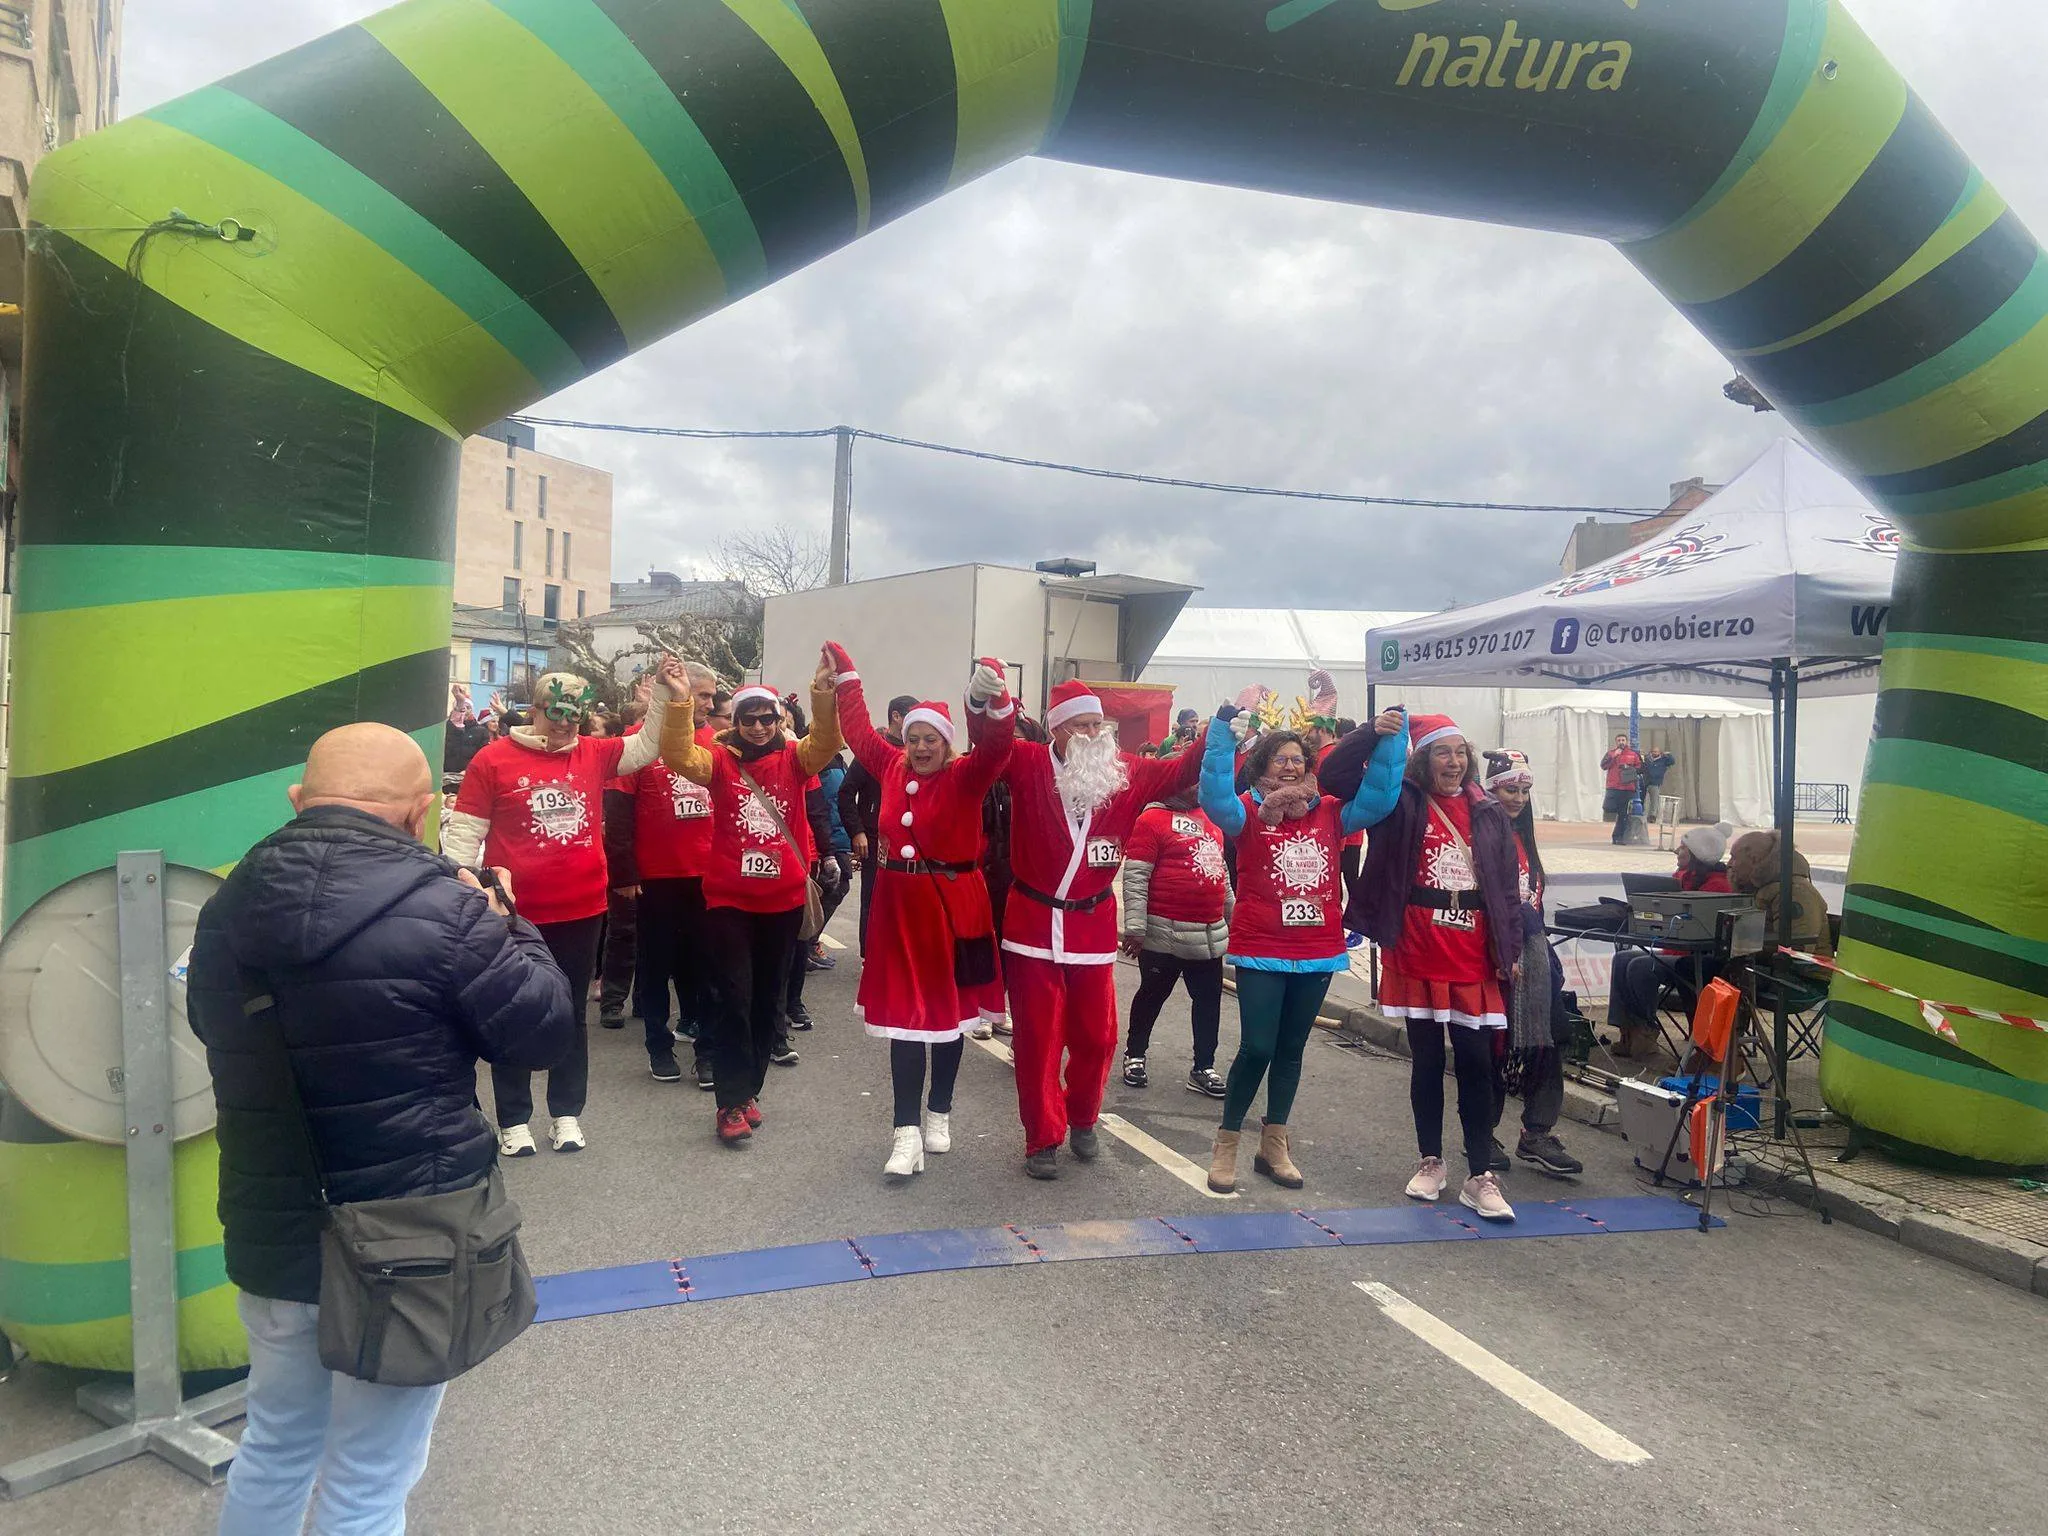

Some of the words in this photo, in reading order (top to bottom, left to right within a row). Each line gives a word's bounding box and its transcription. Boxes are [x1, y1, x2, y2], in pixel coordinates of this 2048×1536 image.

[1395, 19, 1632, 92] natura
[1585, 613, 1755, 647] @Cronobierzo
[1403, 642, 1431, 662] +34
[1435, 638, 1464, 660] 615
[1467, 633, 1498, 656] 970
[1501, 628, 1536, 652] 107
[536, 792, 567, 810] 193
[678, 800, 703, 814] 176
[1175, 819, 1199, 833] 129
[1091, 845, 1116, 861] 137
[746, 857, 773, 873] 192
[1285, 904, 1316, 920] 233
[1440, 908, 1467, 924] 194
